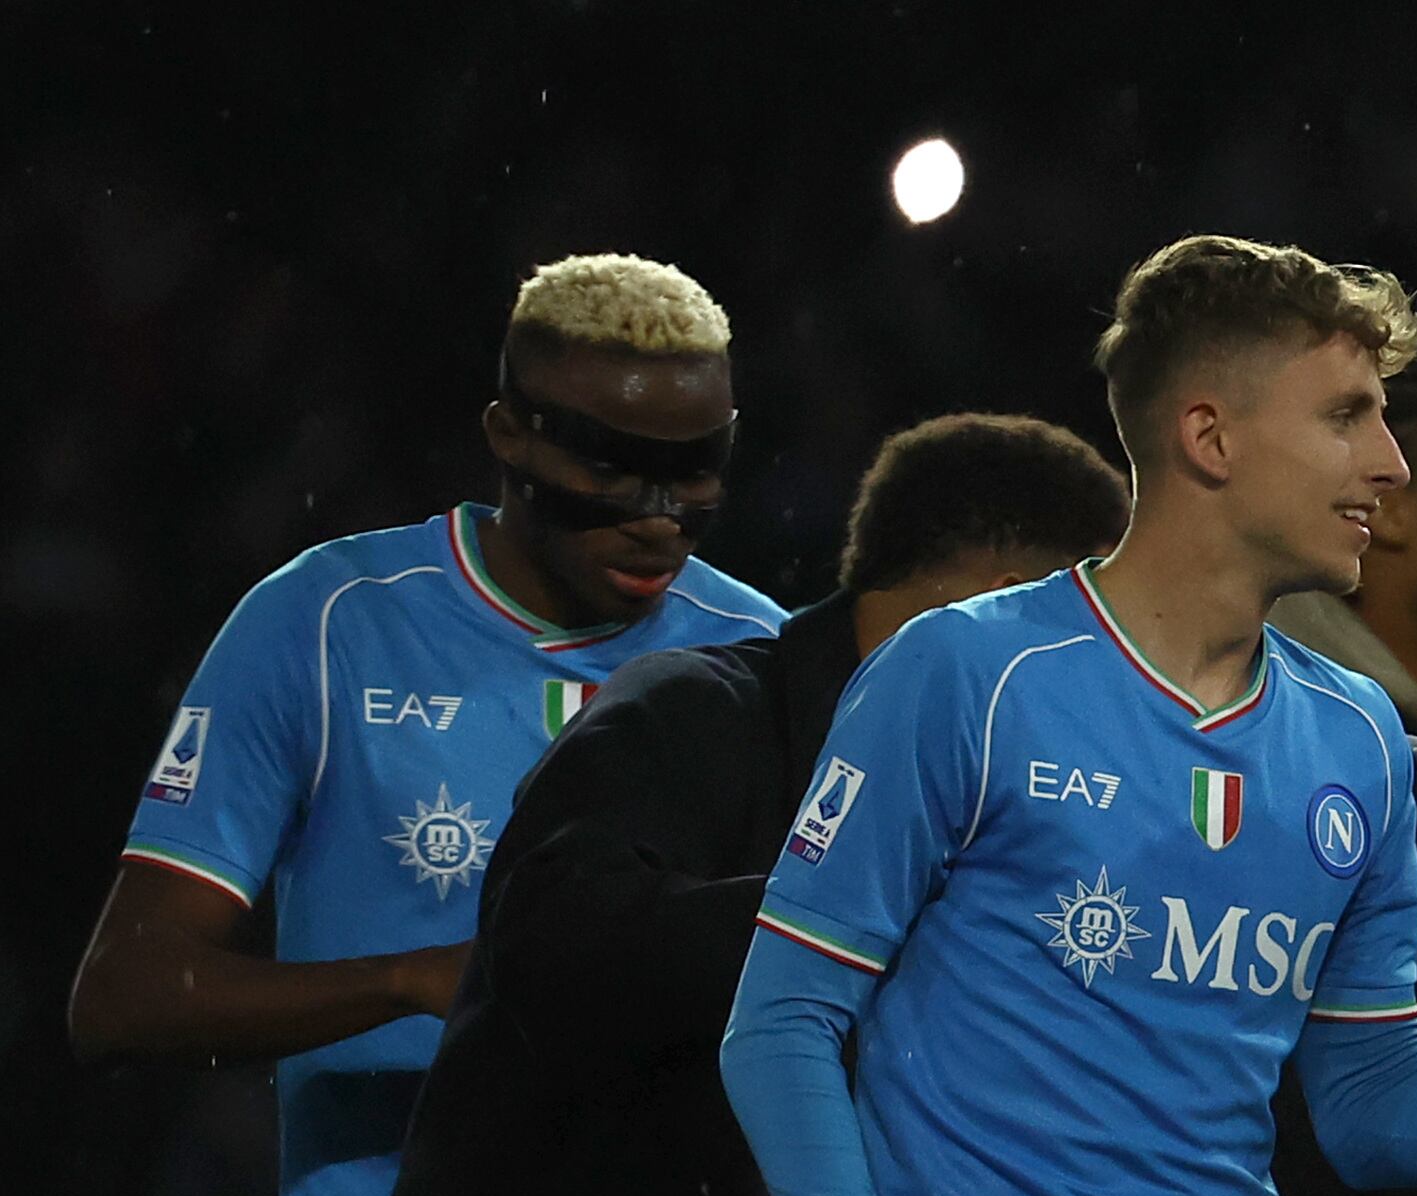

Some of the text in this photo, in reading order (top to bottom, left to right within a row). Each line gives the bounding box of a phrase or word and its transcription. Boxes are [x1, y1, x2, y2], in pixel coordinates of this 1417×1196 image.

[364, 688, 463, 730] EA7
[1028, 760, 1122, 809] EA7
[1324, 807, 1354, 854] N
